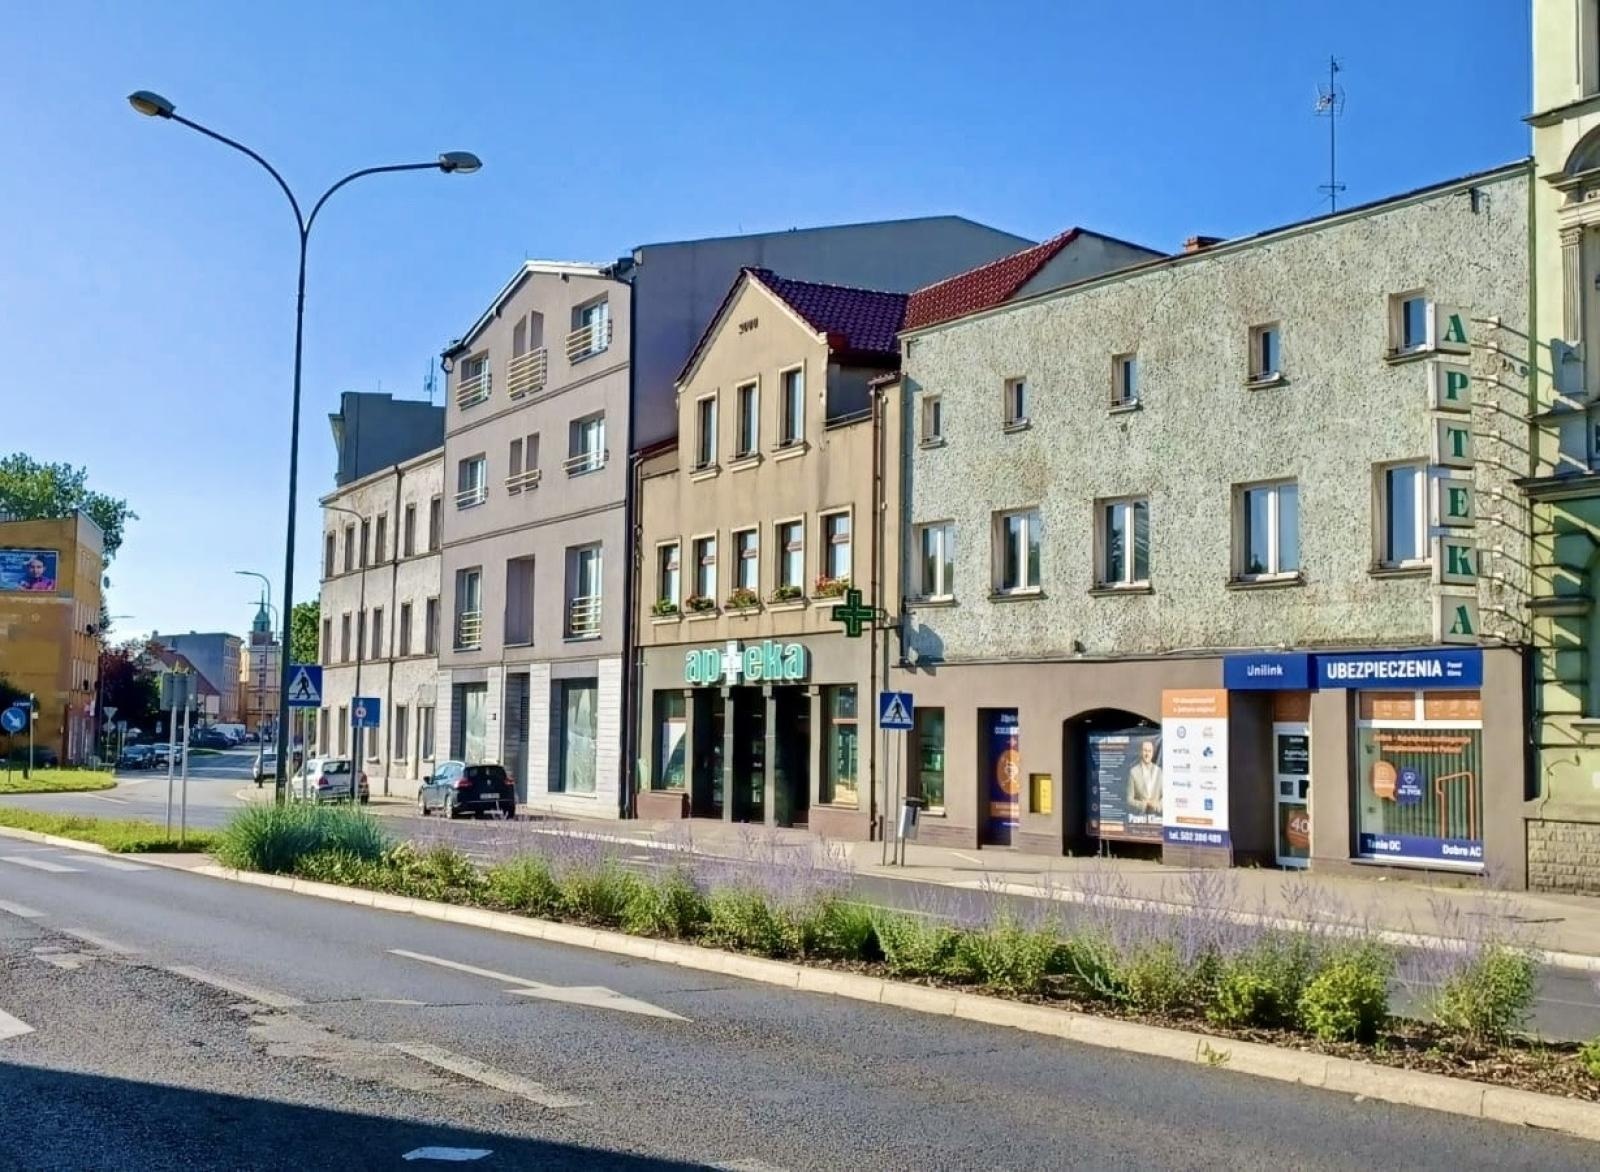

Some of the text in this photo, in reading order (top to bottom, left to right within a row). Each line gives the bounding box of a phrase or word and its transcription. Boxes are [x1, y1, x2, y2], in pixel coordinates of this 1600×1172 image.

[1444, 312, 1473, 635] APTEKA
[1246, 663, 1284, 677] Unilink
[1326, 659, 1443, 680] UBEZPIECZENIA
[1389, 840, 1401, 851] OC
[1470, 846, 1482, 857] AC
